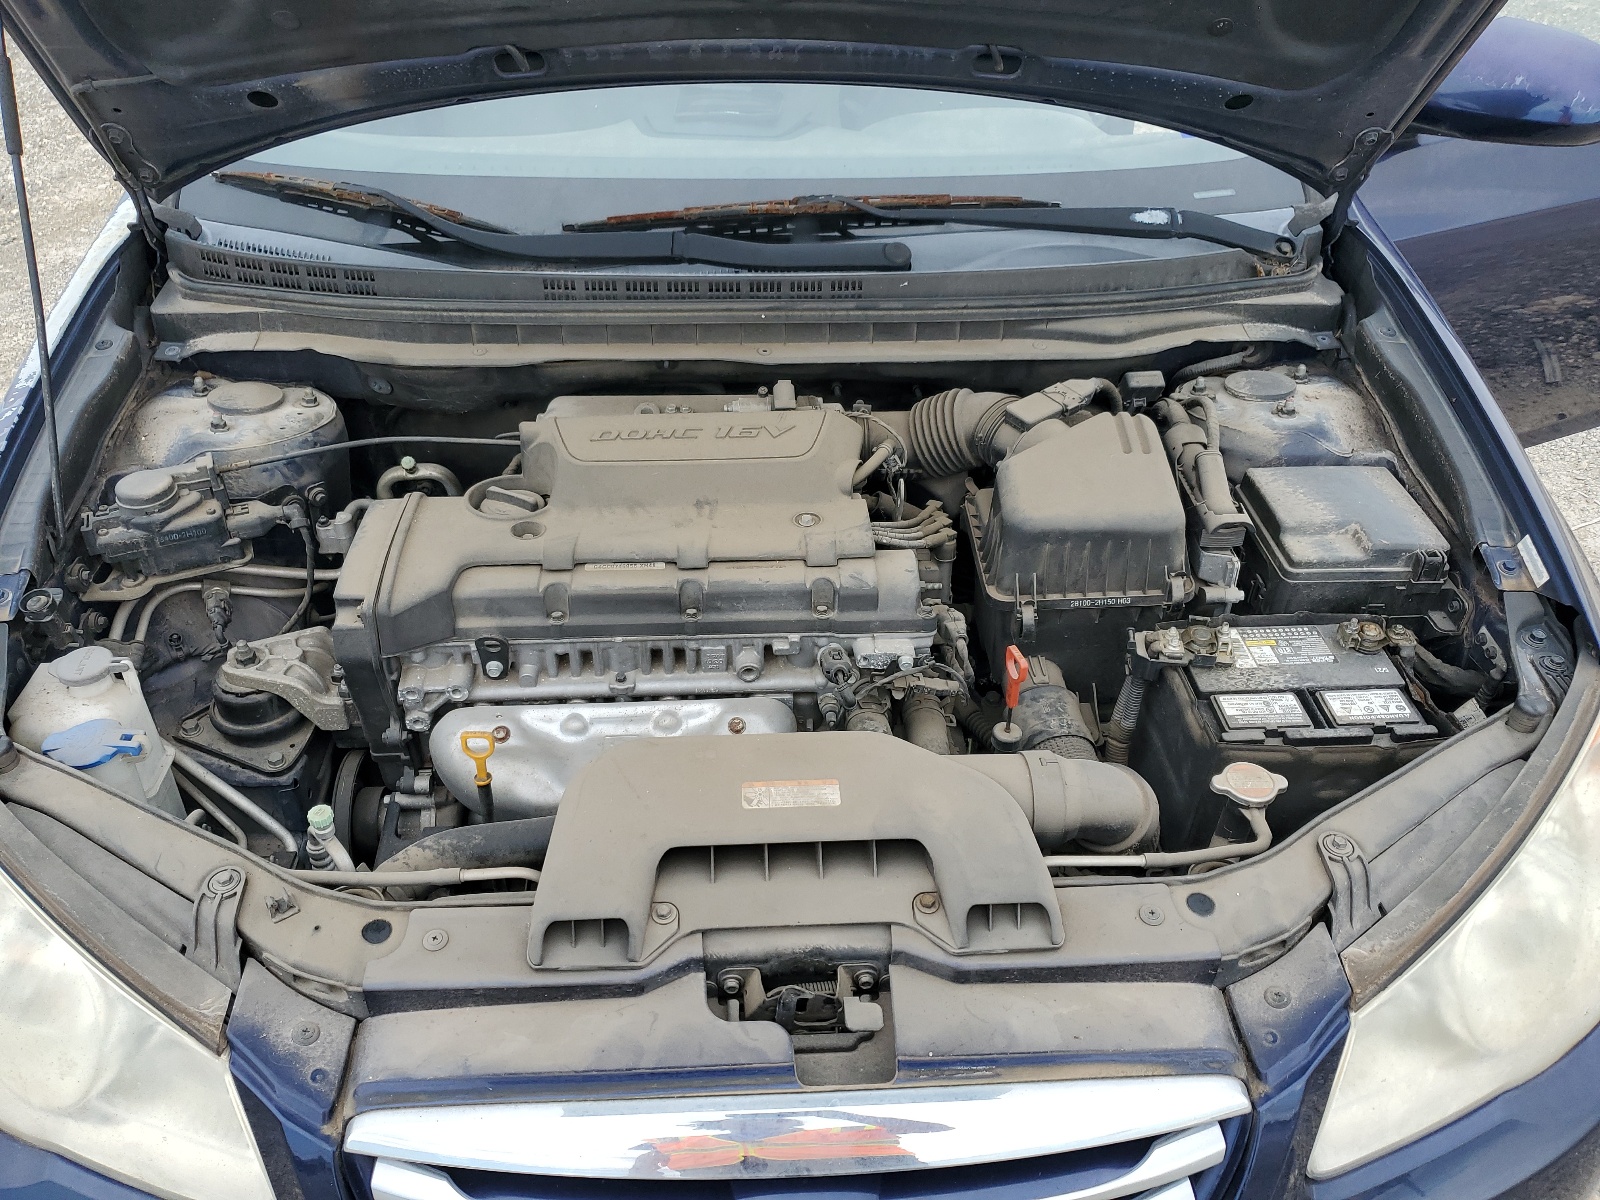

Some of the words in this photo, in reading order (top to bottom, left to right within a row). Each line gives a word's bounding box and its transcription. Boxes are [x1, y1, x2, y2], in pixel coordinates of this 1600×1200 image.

[590, 428, 703, 442] DOHC
[715, 426, 796, 439] 16V
[1070, 599, 1116, 607] 28100-2H150
